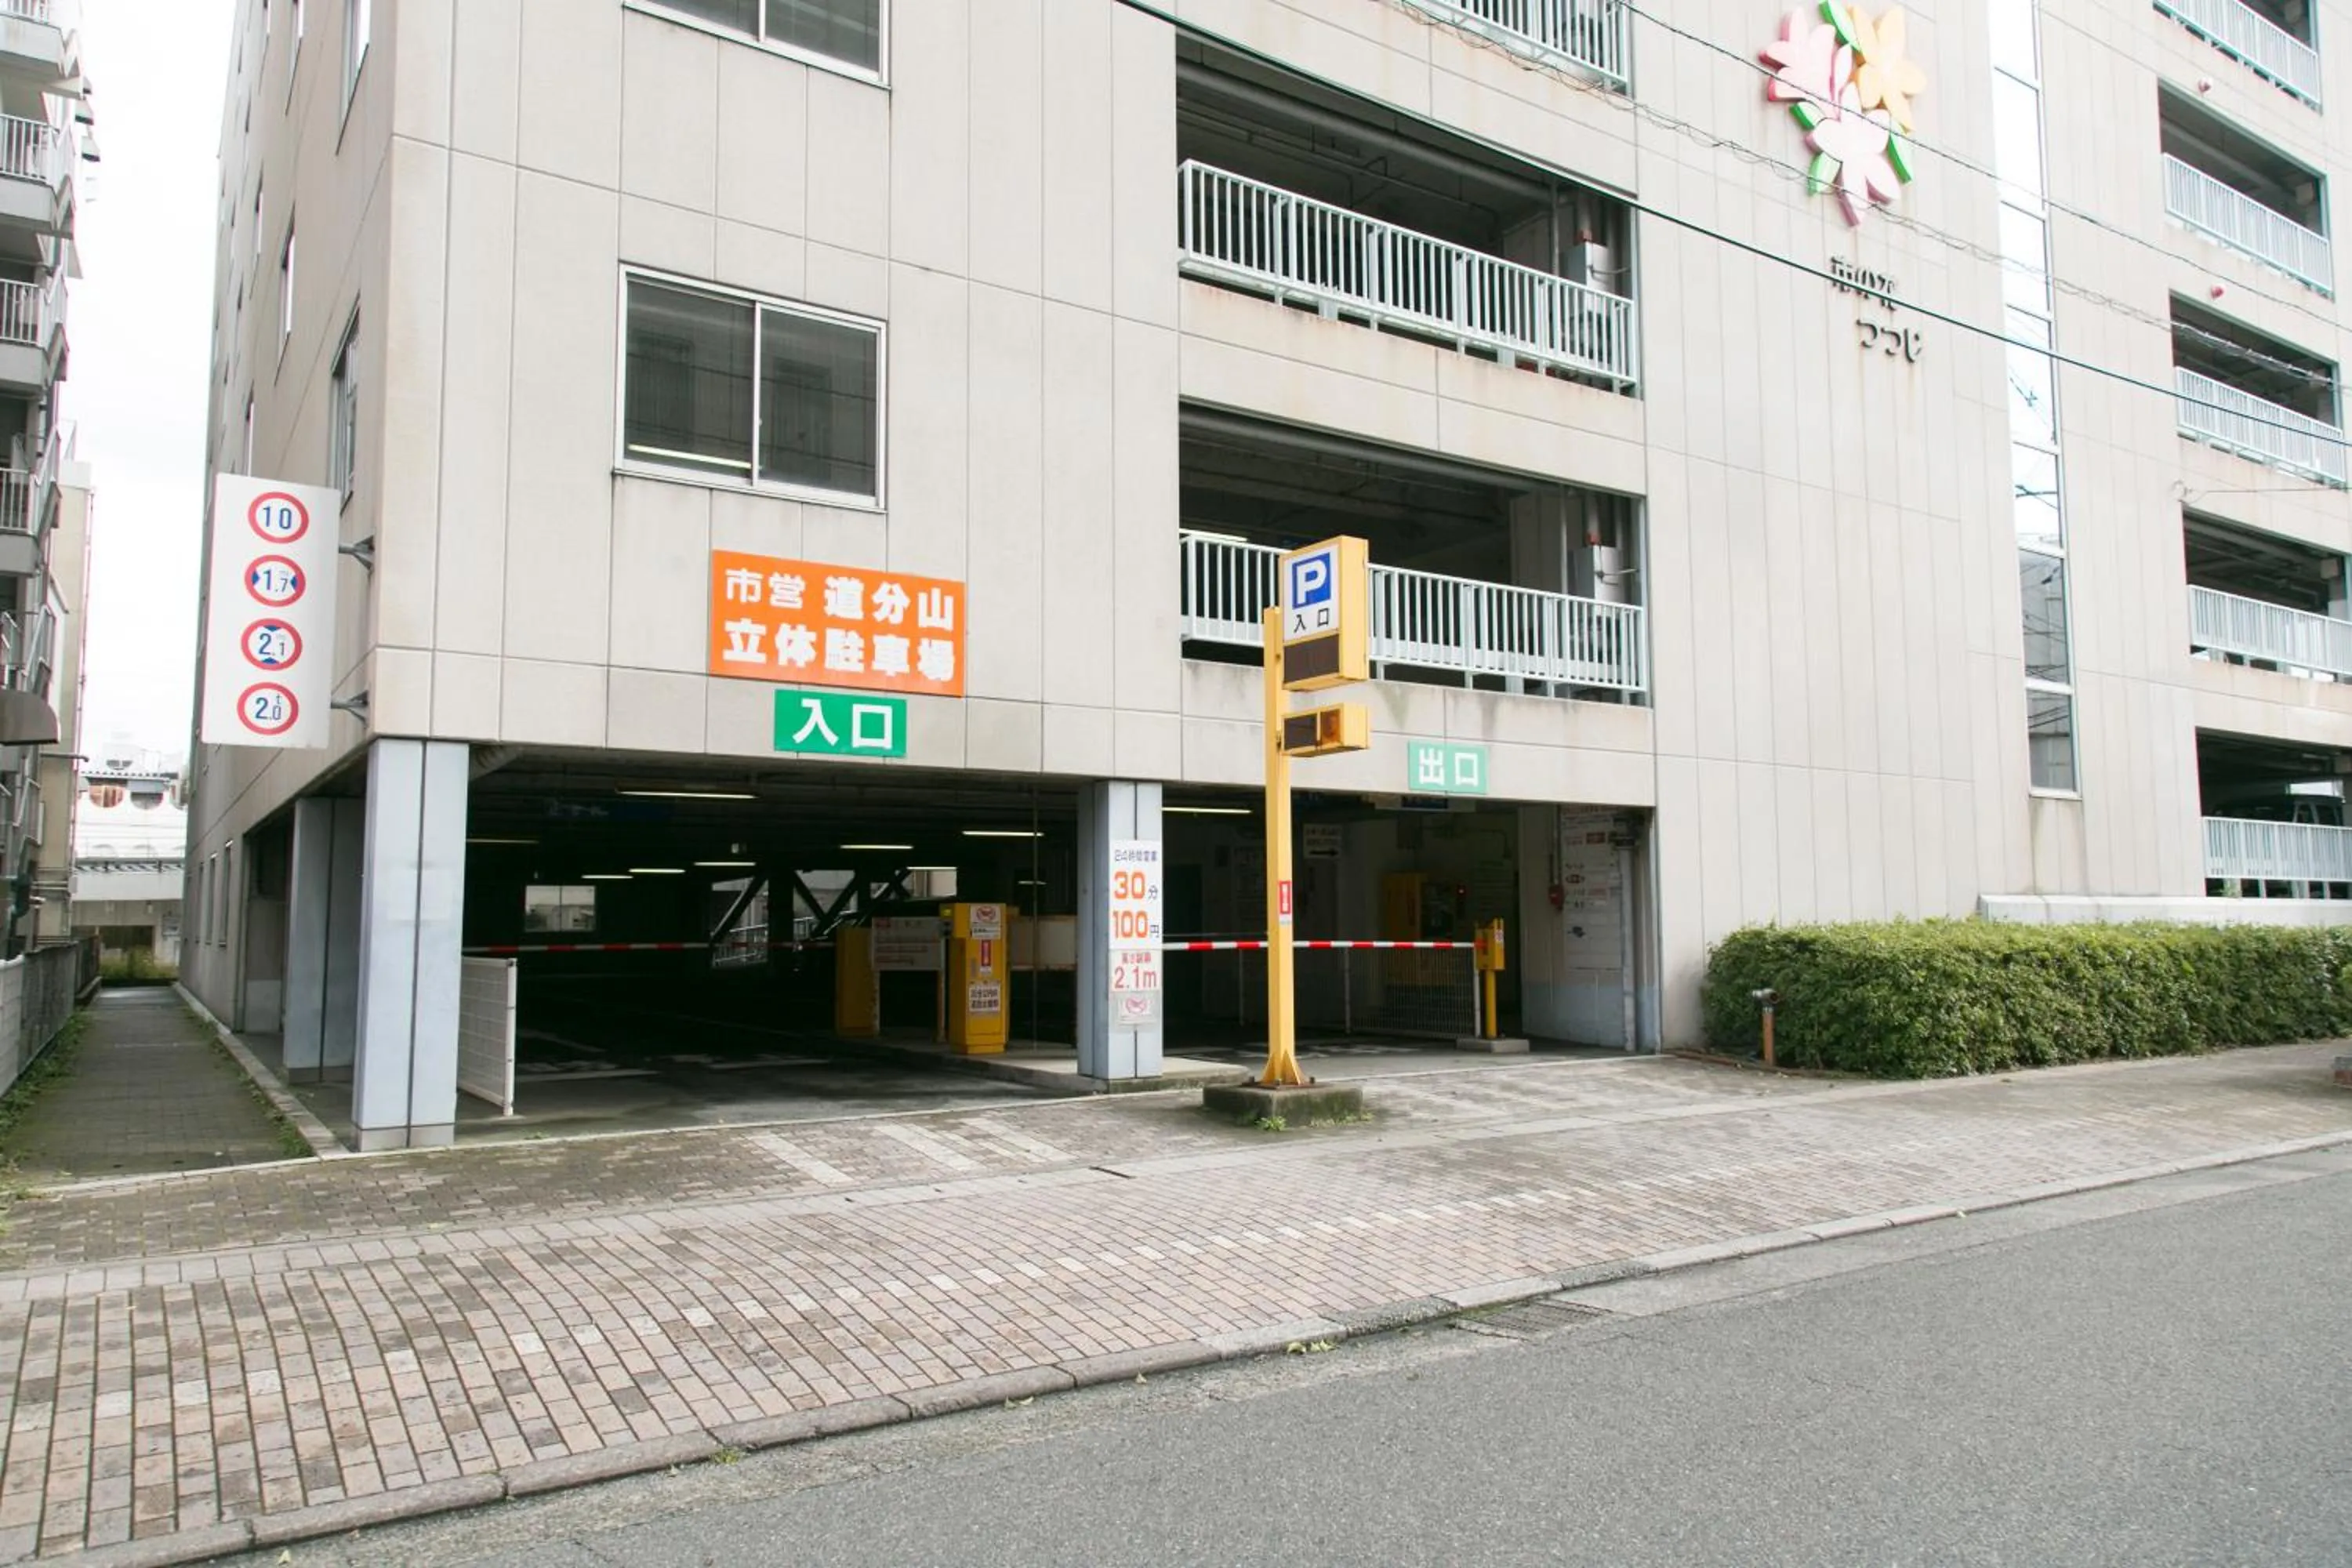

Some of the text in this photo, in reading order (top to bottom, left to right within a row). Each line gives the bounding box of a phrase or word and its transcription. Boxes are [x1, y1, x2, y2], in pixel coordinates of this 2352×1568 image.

[1855, 319, 1922, 363] つつじ
[263, 506, 292, 529] 10
[263, 568, 289, 592] 1.7
[1296, 561, 1327, 605] P
[724, 568, 954, 631] 市営 道分山
[1294, 608, 1330, 633] 入口
[258, 633, 285, 656] 2.1
[722, 618, 956, 681] 立体駐車場
[255, 697, 282, 720] 2.0
[792, 699, 893, 750] 入口
[1418, 747, 1479, 787] 出口
[1114, 871, 1159, 900] 30分
[1112, 910, 1160, 938] 100円
[1114, 966, 1157, 989] 2.1m
